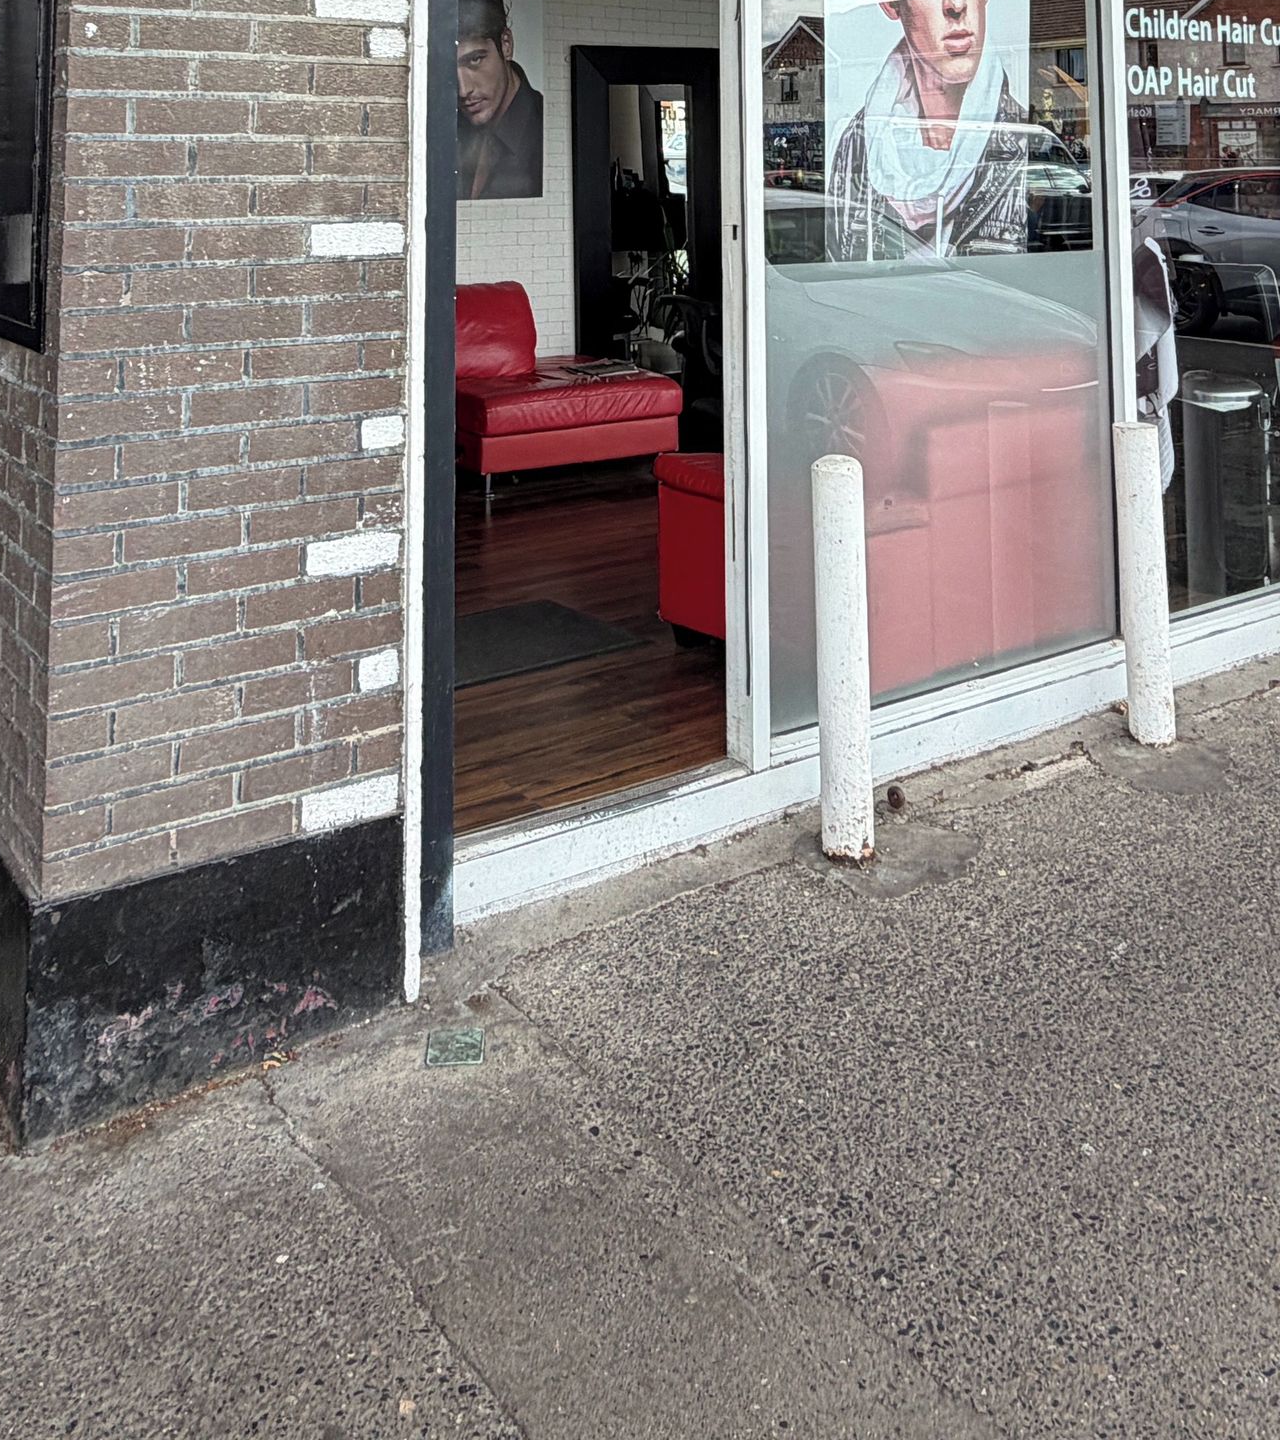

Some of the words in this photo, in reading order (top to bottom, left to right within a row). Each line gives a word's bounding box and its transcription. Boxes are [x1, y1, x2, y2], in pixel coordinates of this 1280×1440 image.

[1125, 7, 1213, 43] Children
[1217, 14, 1257, 45] Hair
[1127, 65, 1173, 96] OAP
[1177, 66, 1219, 97] Hair
[1223, 69, 1257, 99] Cut
